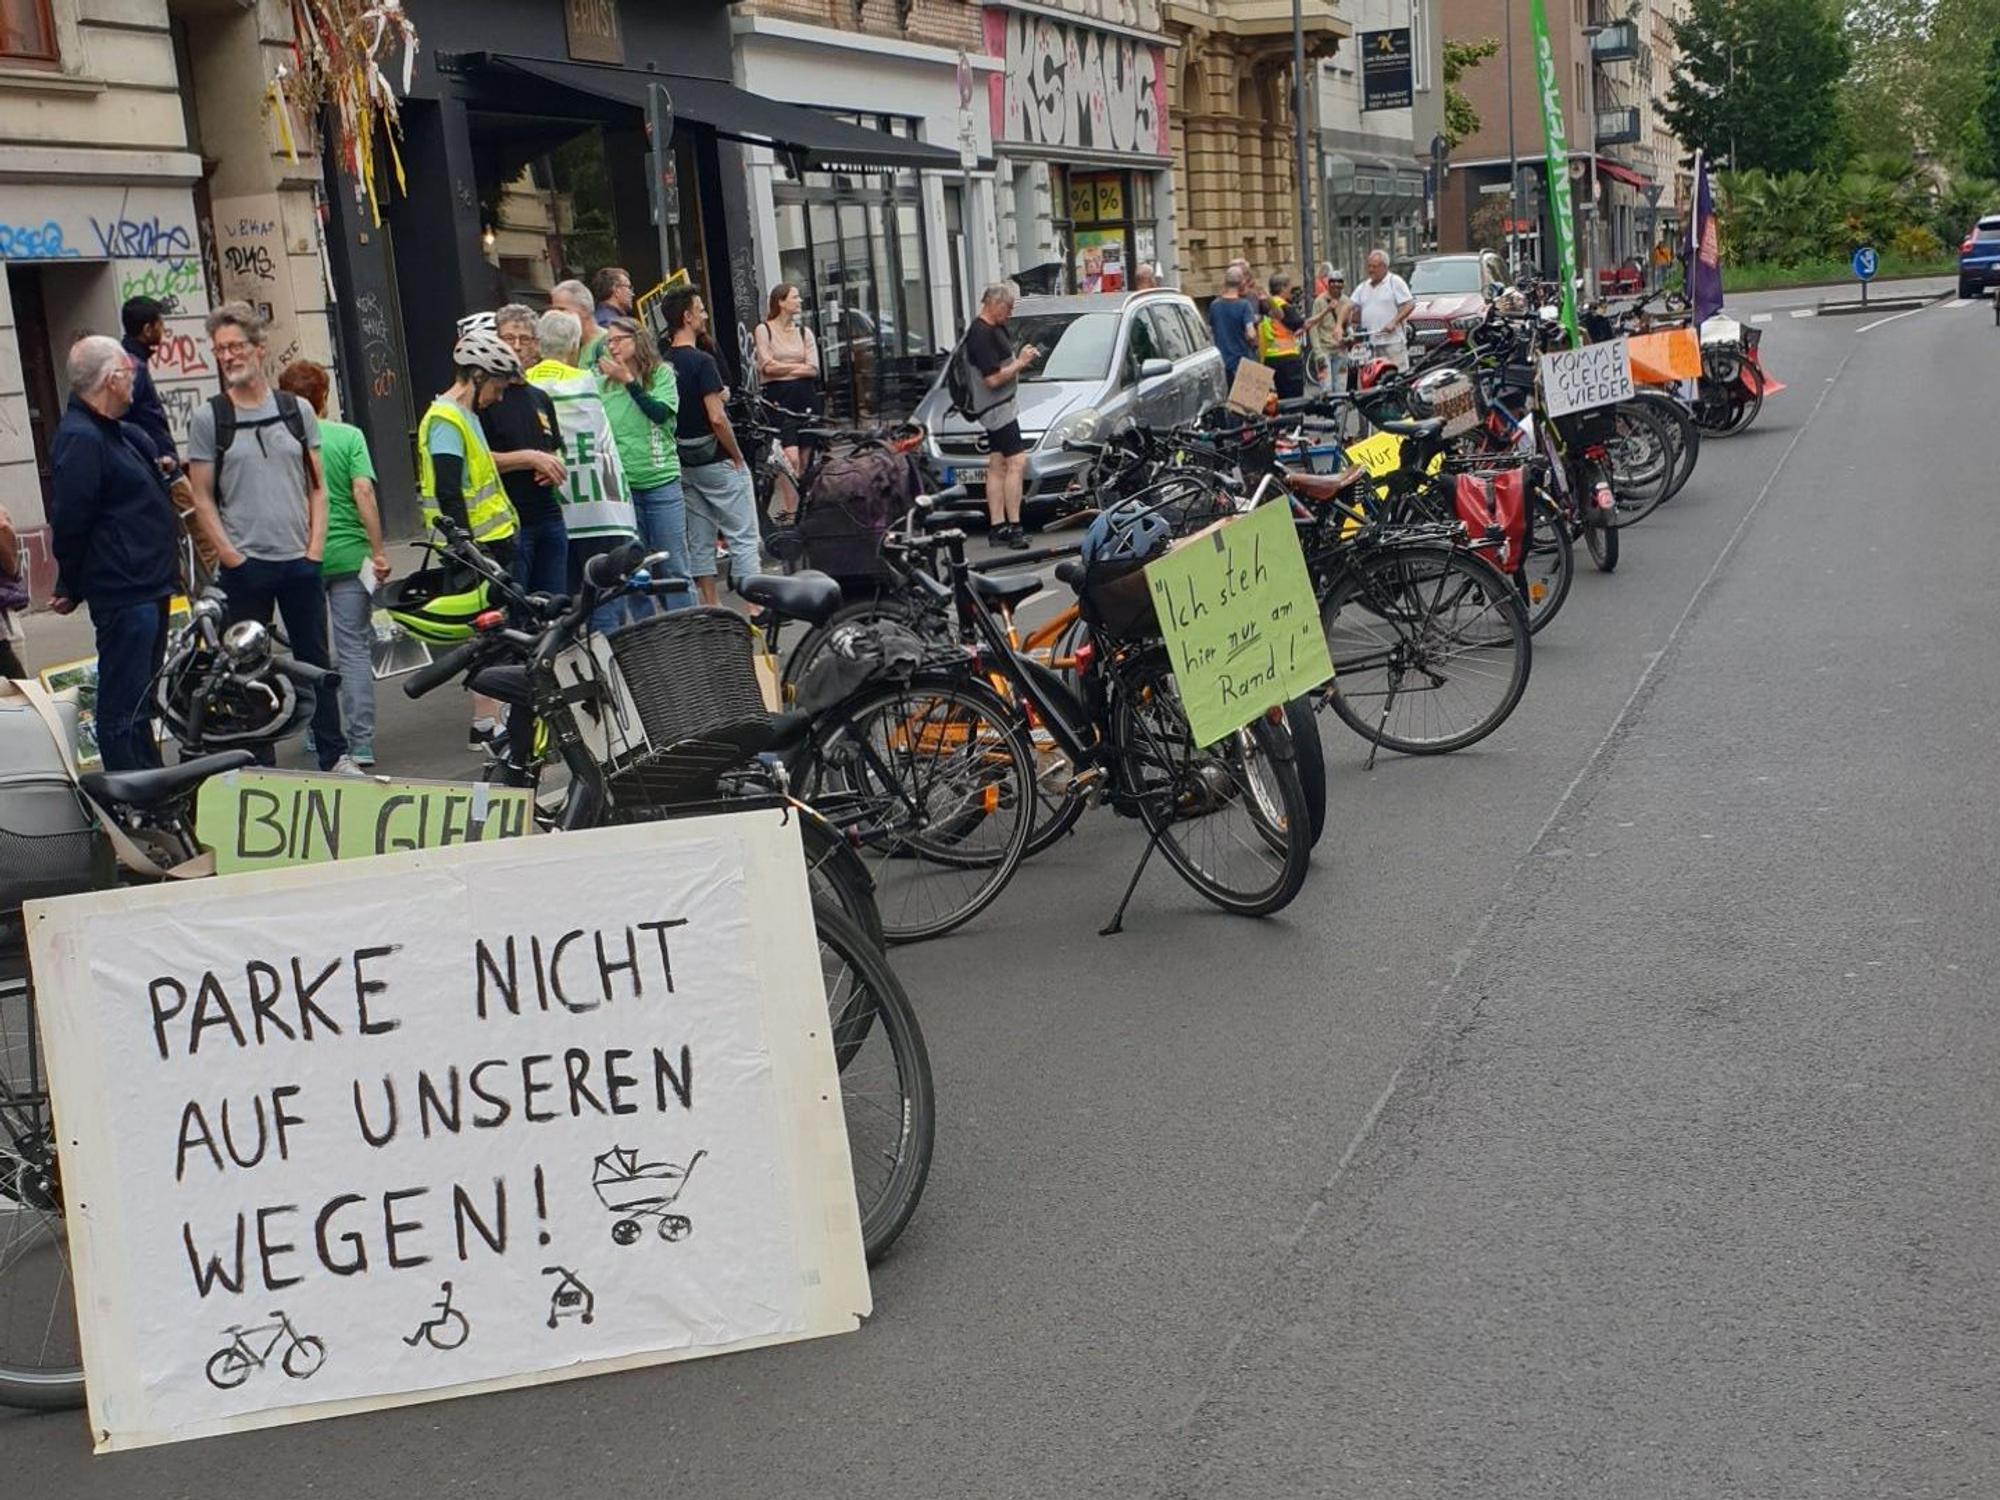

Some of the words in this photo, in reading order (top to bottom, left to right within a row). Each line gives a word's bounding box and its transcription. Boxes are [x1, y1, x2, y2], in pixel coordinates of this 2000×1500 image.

[1551, 342, 1622, 374] KOMME
[1559, 362, 1623, 391] GLEICH
[1566, 378, 1630, 407] WIEDER
[1358, 448, 1391, 469] Nur
[1220, 533, 1267, 606] steh
[1183, 641, 1216, 674] hier
[1227, 622, 1258, 647] nur
[1271, 601, 1293, 621] am
[237, 788, 342, 860] BIN
[149, 943, 403, 1059] PARKE
[476, 918, 688, 1020] NICHT
[176, 1085, 303, 1181] AUF
[353, 1044, 694, 1150] UNSEREN
[184, 1163, 551, 1299] WEGEN!
